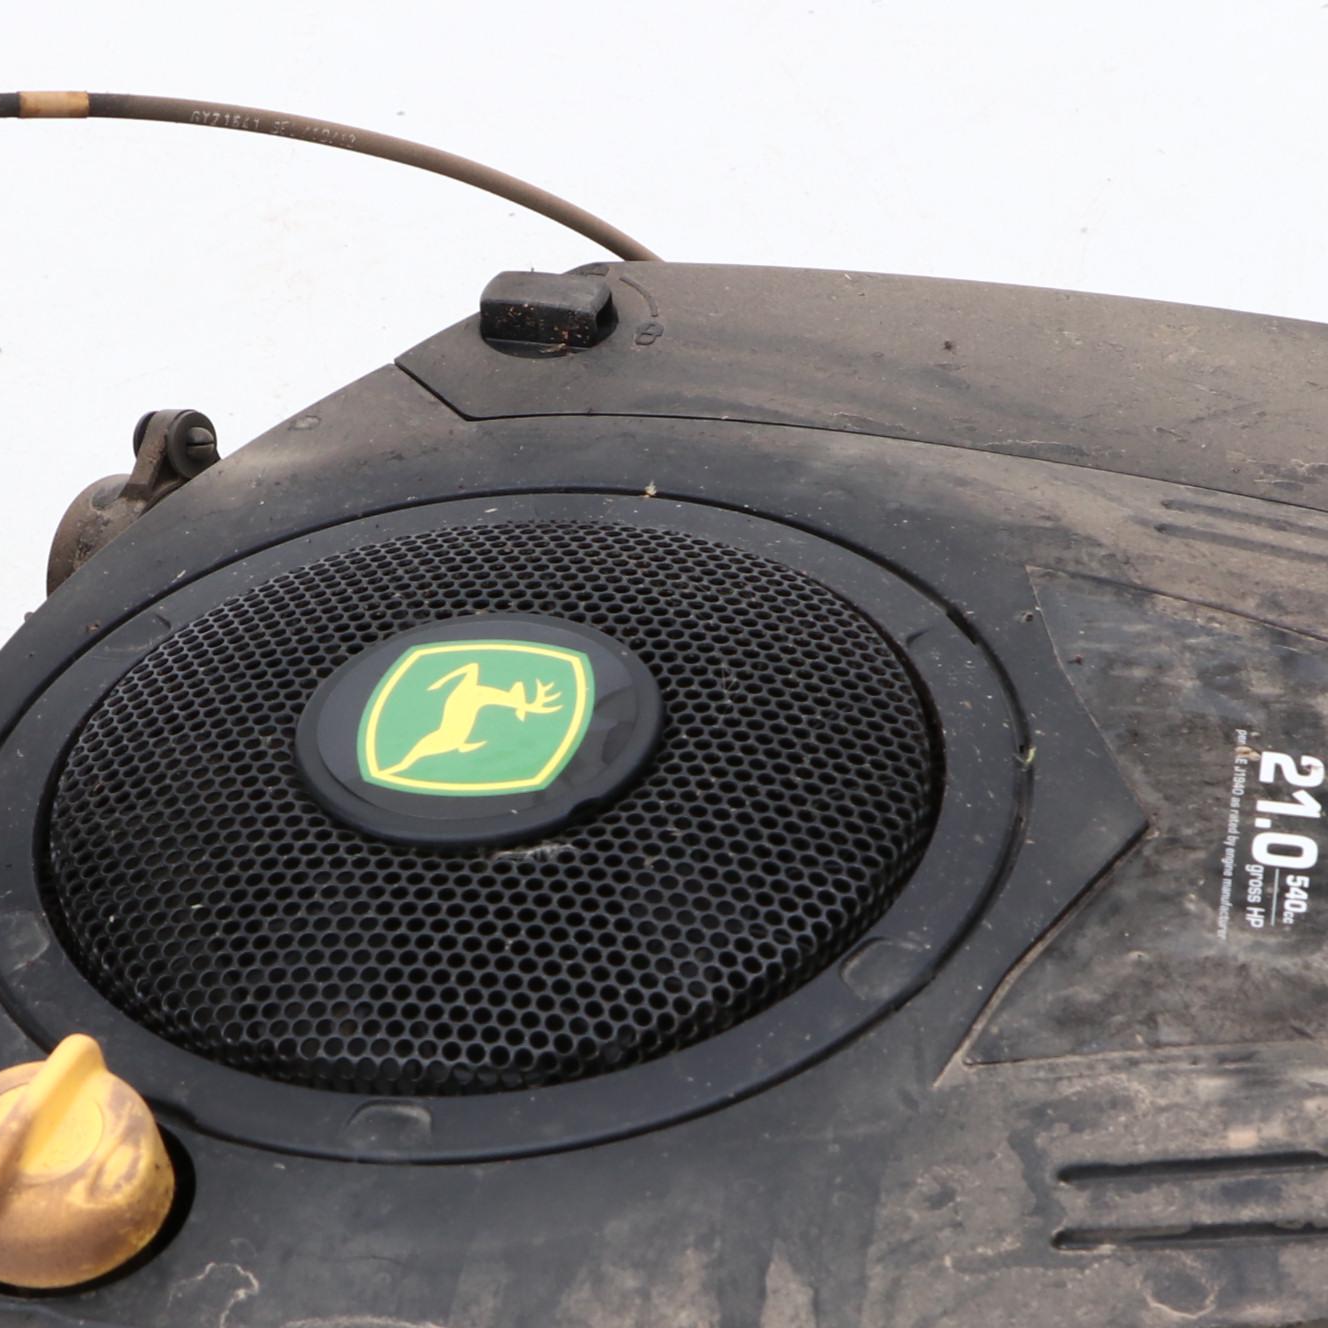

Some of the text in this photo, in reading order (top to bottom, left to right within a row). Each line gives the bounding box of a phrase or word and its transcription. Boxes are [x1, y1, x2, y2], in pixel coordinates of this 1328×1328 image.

[1235, 729, 1248, 744] per
[1232, 768, 1247, 796] J1940
[1230, 797, 1241, 808] as
[1228, 809, 1242, 834] rated
[1224, 835, 1240, 846] by
[1251, 751, 1325, 925] 21.0 540cc
[1221, 846, 1237, 877] engine
[1217, 878, 1234, 940] manufacturer
[1245, 864, 1265, 928] gross HP
